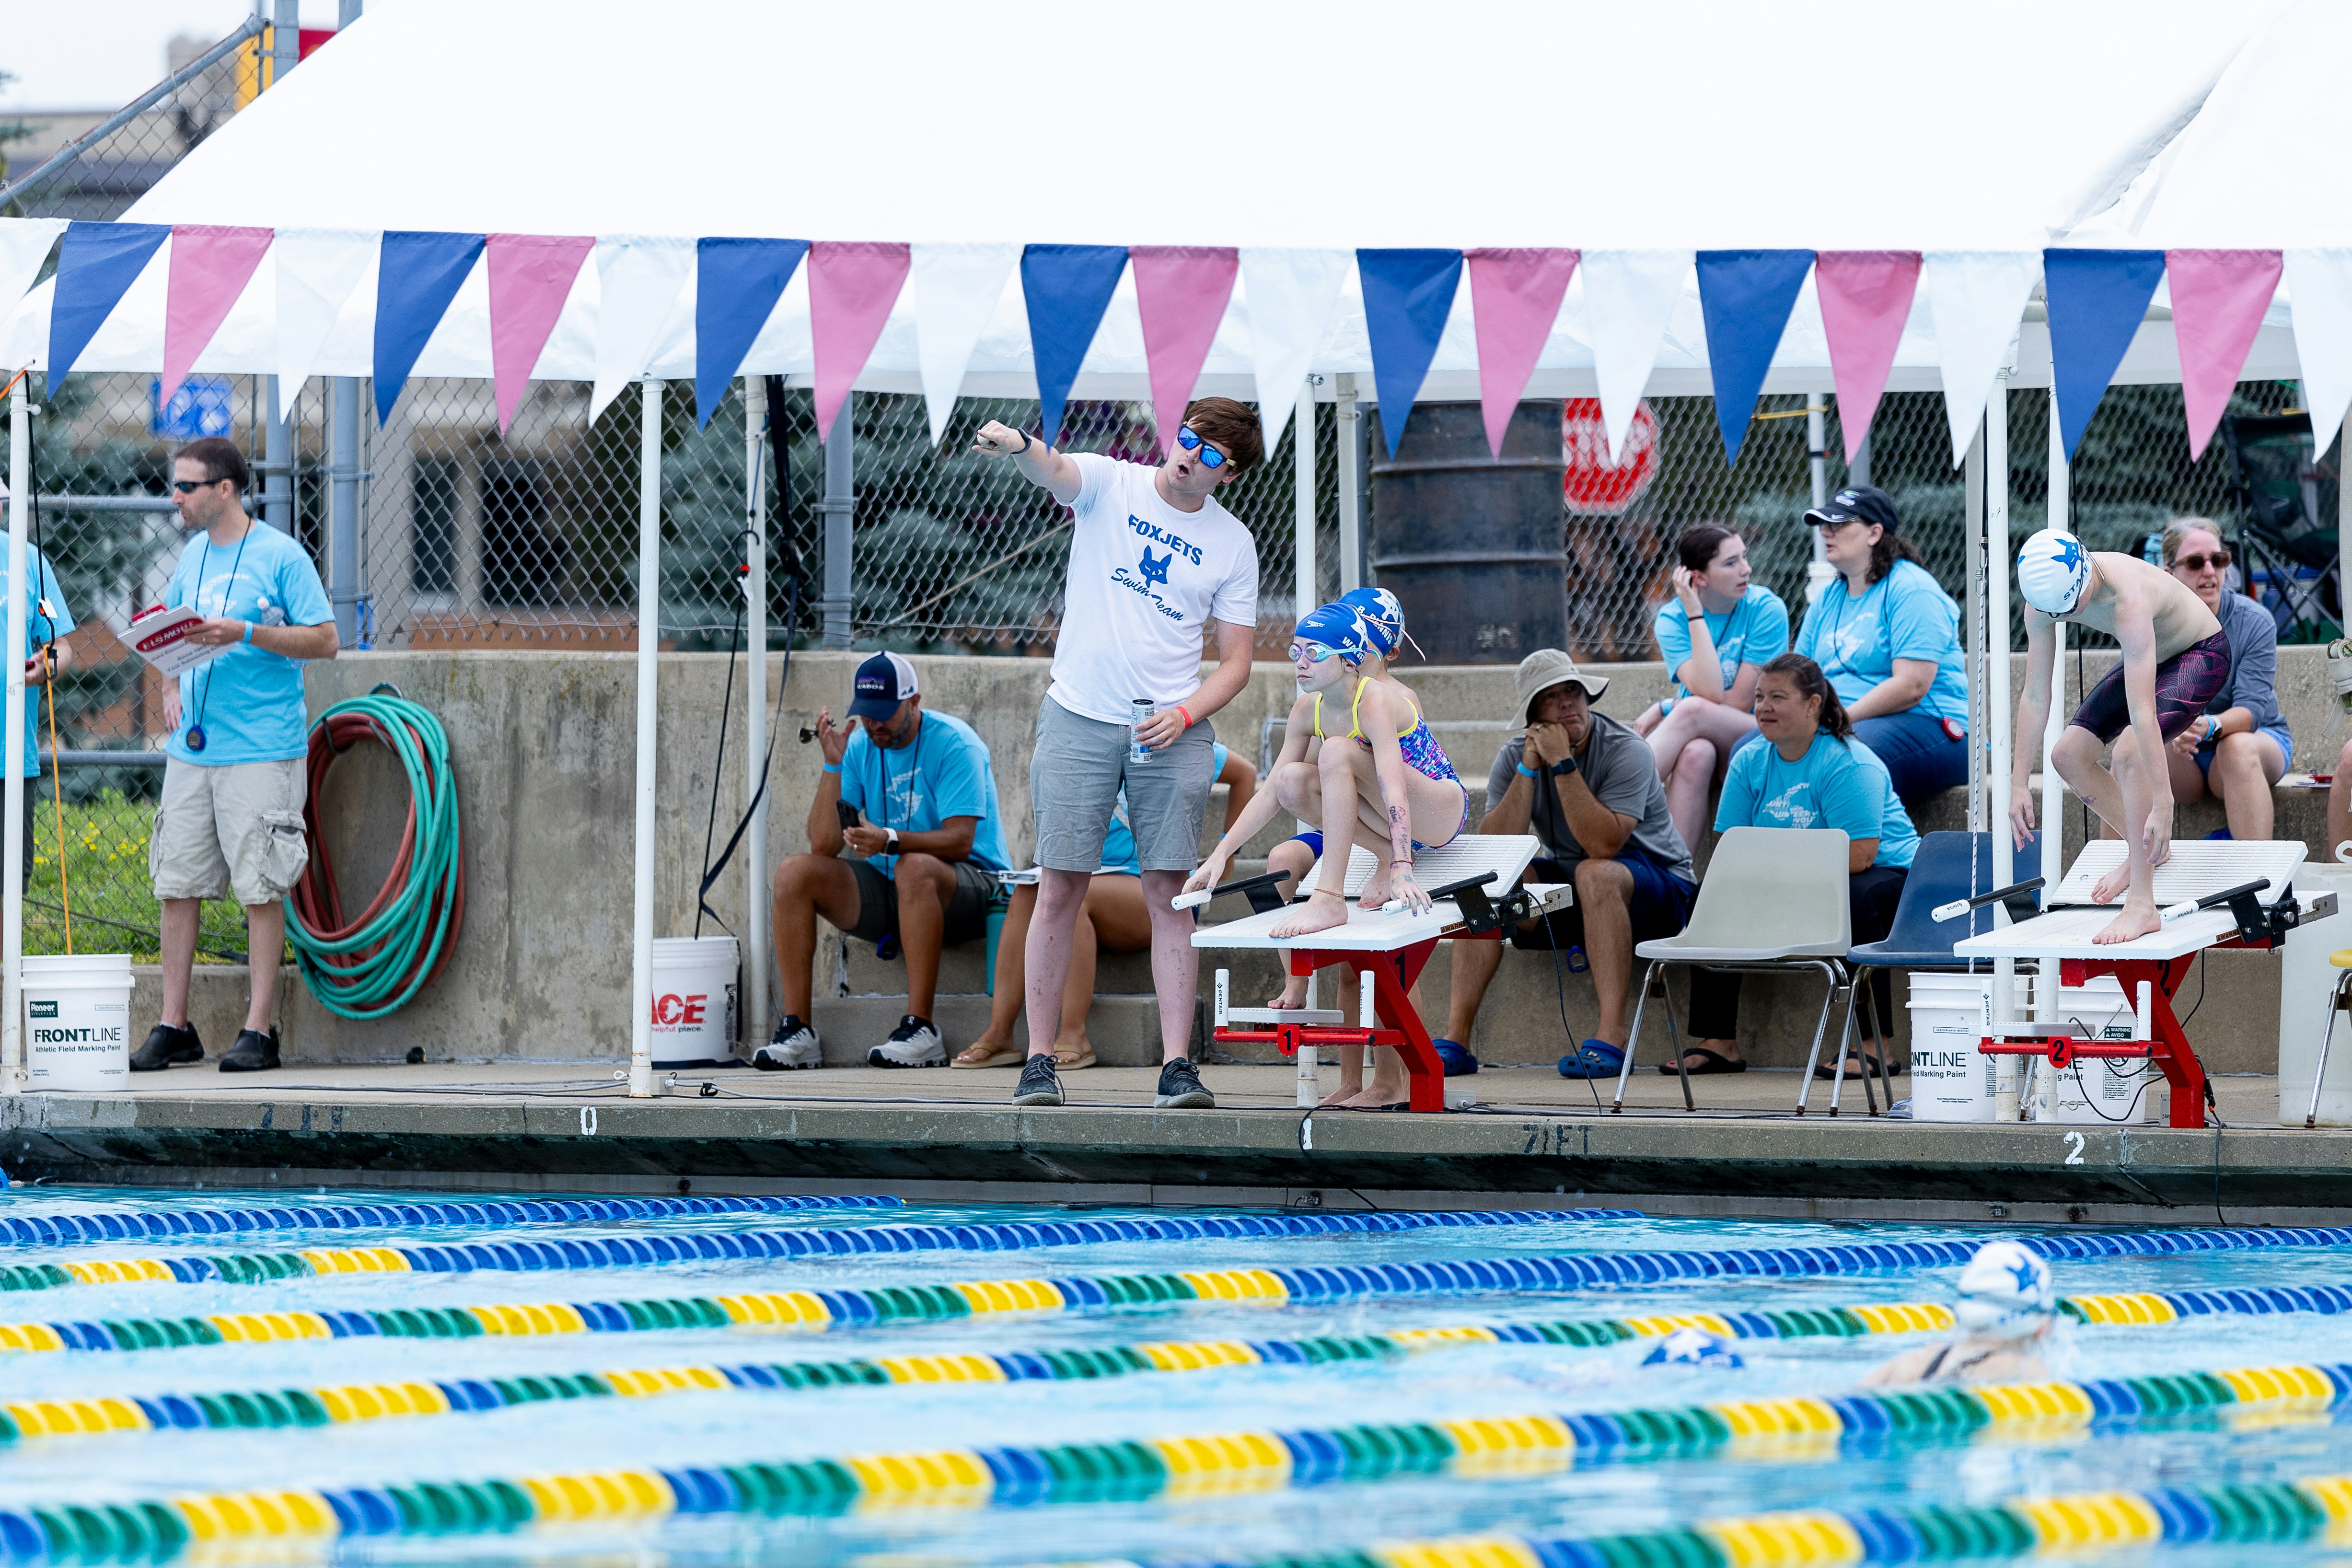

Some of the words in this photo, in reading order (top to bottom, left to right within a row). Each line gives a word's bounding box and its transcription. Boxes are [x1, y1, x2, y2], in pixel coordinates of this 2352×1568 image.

[1128, 514, 1203, 566] FOXJETS
[1111, 568, 1150, 596] Swim
[1151, 594, 1183, 621] Team
[1444, 921, 1467, 932] WARN
[2219, 929, 2239, 941] WARN
[1395, 951, 1405, 992] 1
[2157, 959, 2170, 997] 2
[31, 1003, 55, 1011] Pioneer
[34, 1027, 121, 1043] FRONTLINE
[1284, 1029, 1291, 1051] 1
[1912, 1052, 1967, 1067] ONTLINE
[2052, 1040, 2064, 1062] 2
[1920, 1070, 1944, 1079] Marking
[1523, 1125, 1539, 1153] 7
[1556, 1124, 1594, 1156] FT
[2063, 1131, 2085, 1165] 2
